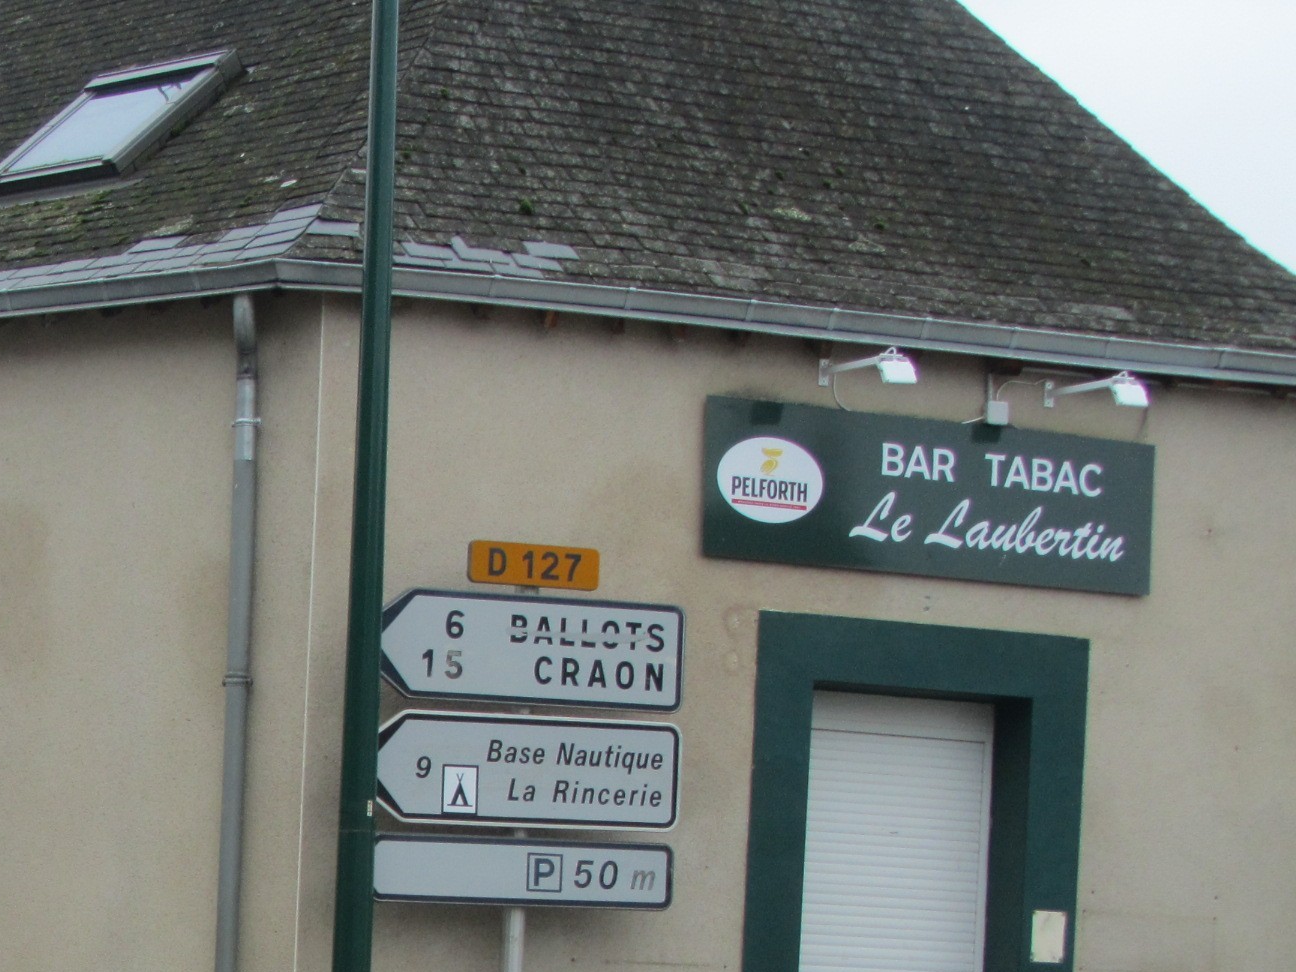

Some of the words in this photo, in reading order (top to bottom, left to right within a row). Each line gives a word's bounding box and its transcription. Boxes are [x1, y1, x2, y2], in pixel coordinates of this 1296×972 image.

[880, 442, 956, 483] BAR
[985, 453, 1104, 498] TABAC
[731, 476, 808, 503] PELFORTH
[848, 491, 912, 542] Le
[924, 498, 1125, 563] Laubertin
[488, 548, 508, 577] D
[521, 550, 583, 583] 127
[445, 609, 465, 640] 6
[509, 614, 666, 653] BALLOTS
[421, 648, 464, 680] 15
[534, 655, 665, 693] CRAON
[415, 756, 432, 779] 9
[486, 739, 546, 765] Base
[556, 742, 664, 775] Nautique
[507, 778, 536, 802] La
[552, 779, 663, 808] Rincerie
[532, 858, 556, 888] P
[573, 859, 619, 890] 50
[630, 868, 657, 892] m
